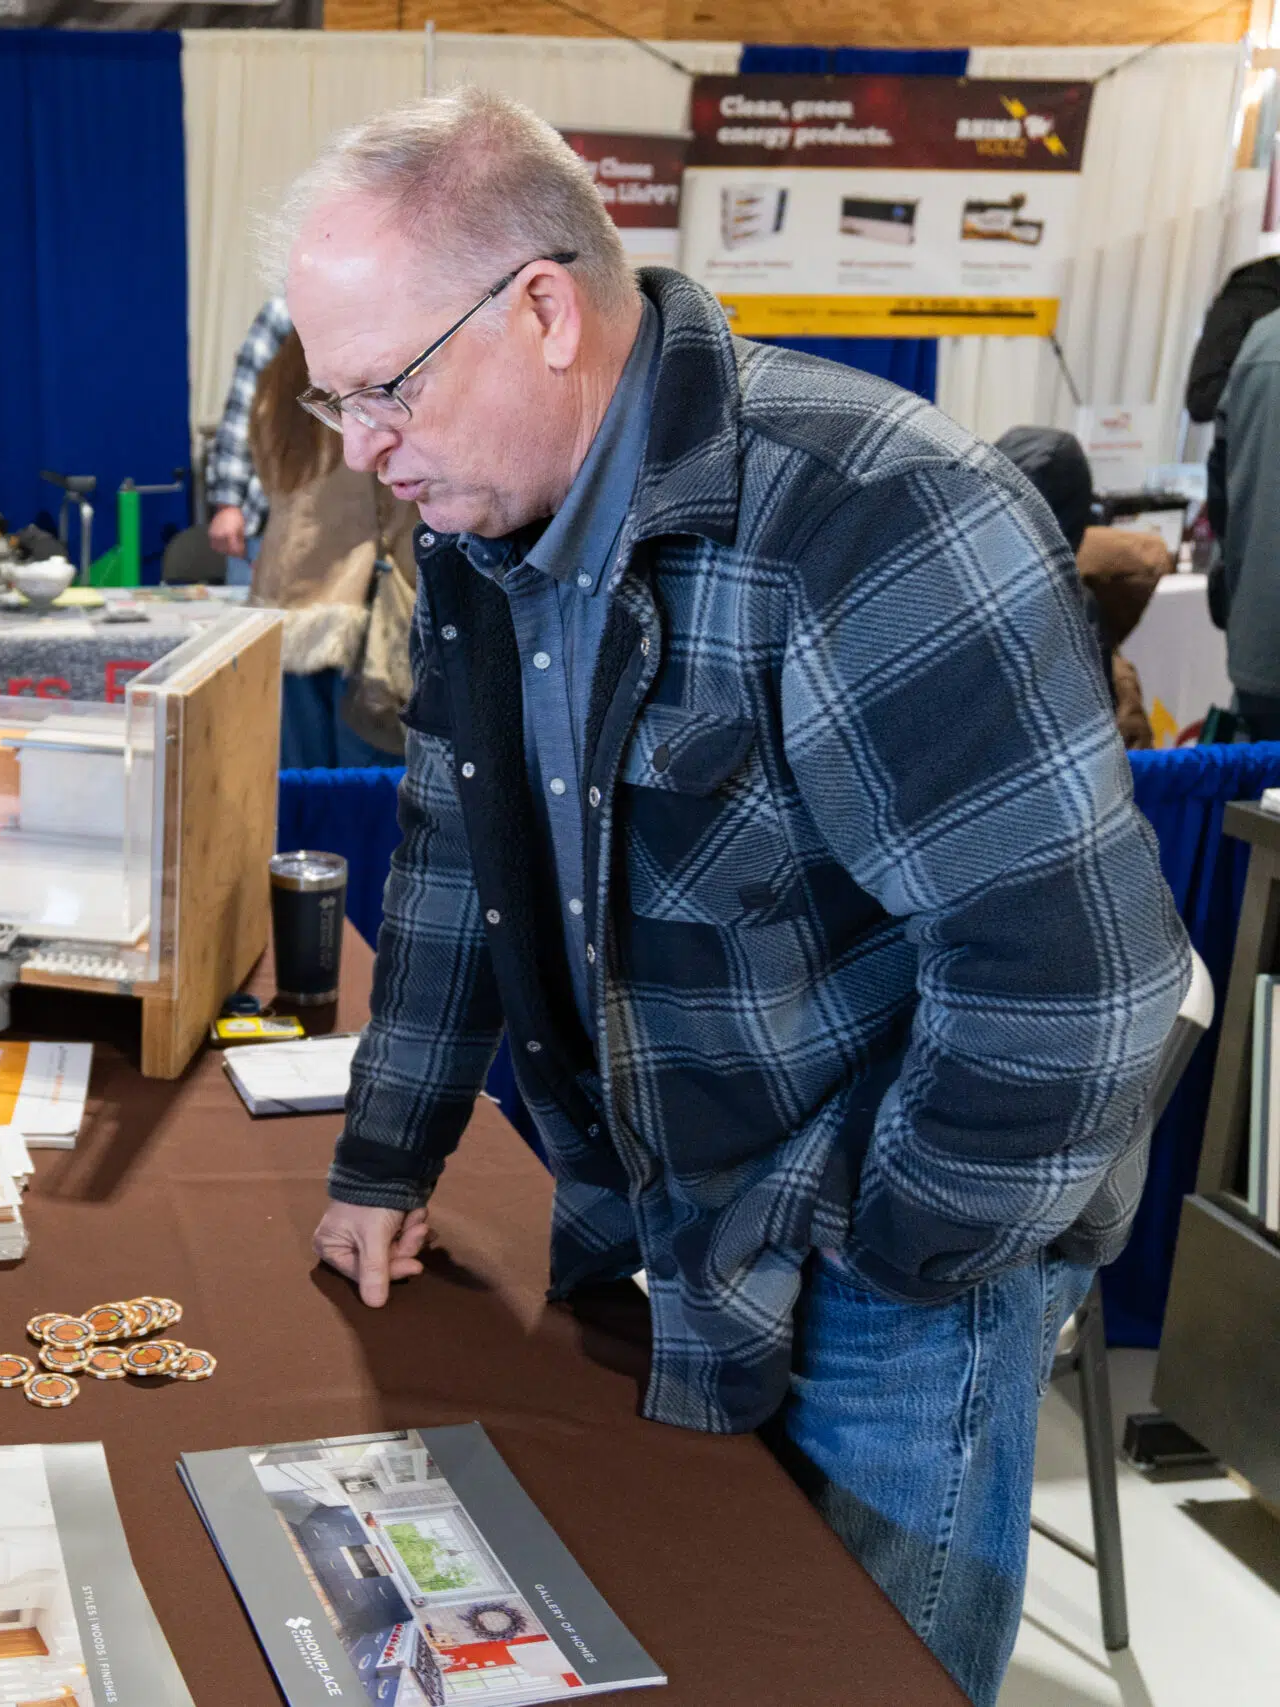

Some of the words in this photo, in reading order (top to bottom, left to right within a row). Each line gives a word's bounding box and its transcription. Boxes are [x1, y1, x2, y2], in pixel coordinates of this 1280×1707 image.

[716, 126, 792, 149] energy
[719, 94, 789, 121] Clean,
[791, 100, 854, 122] green
[81, 1585, 97, 1616] STYLES
[89, 1622, 107, 1656] WOODS
[99, 1662, 118, 1704] FINISHES
[534, 1583, 566, 1620] GALLERY
[560, 1621, 576, 1634] OF
[569, 1634, 598, 1664] HOMES
[299, 1627, 344, 1697] SHOWPLACE
